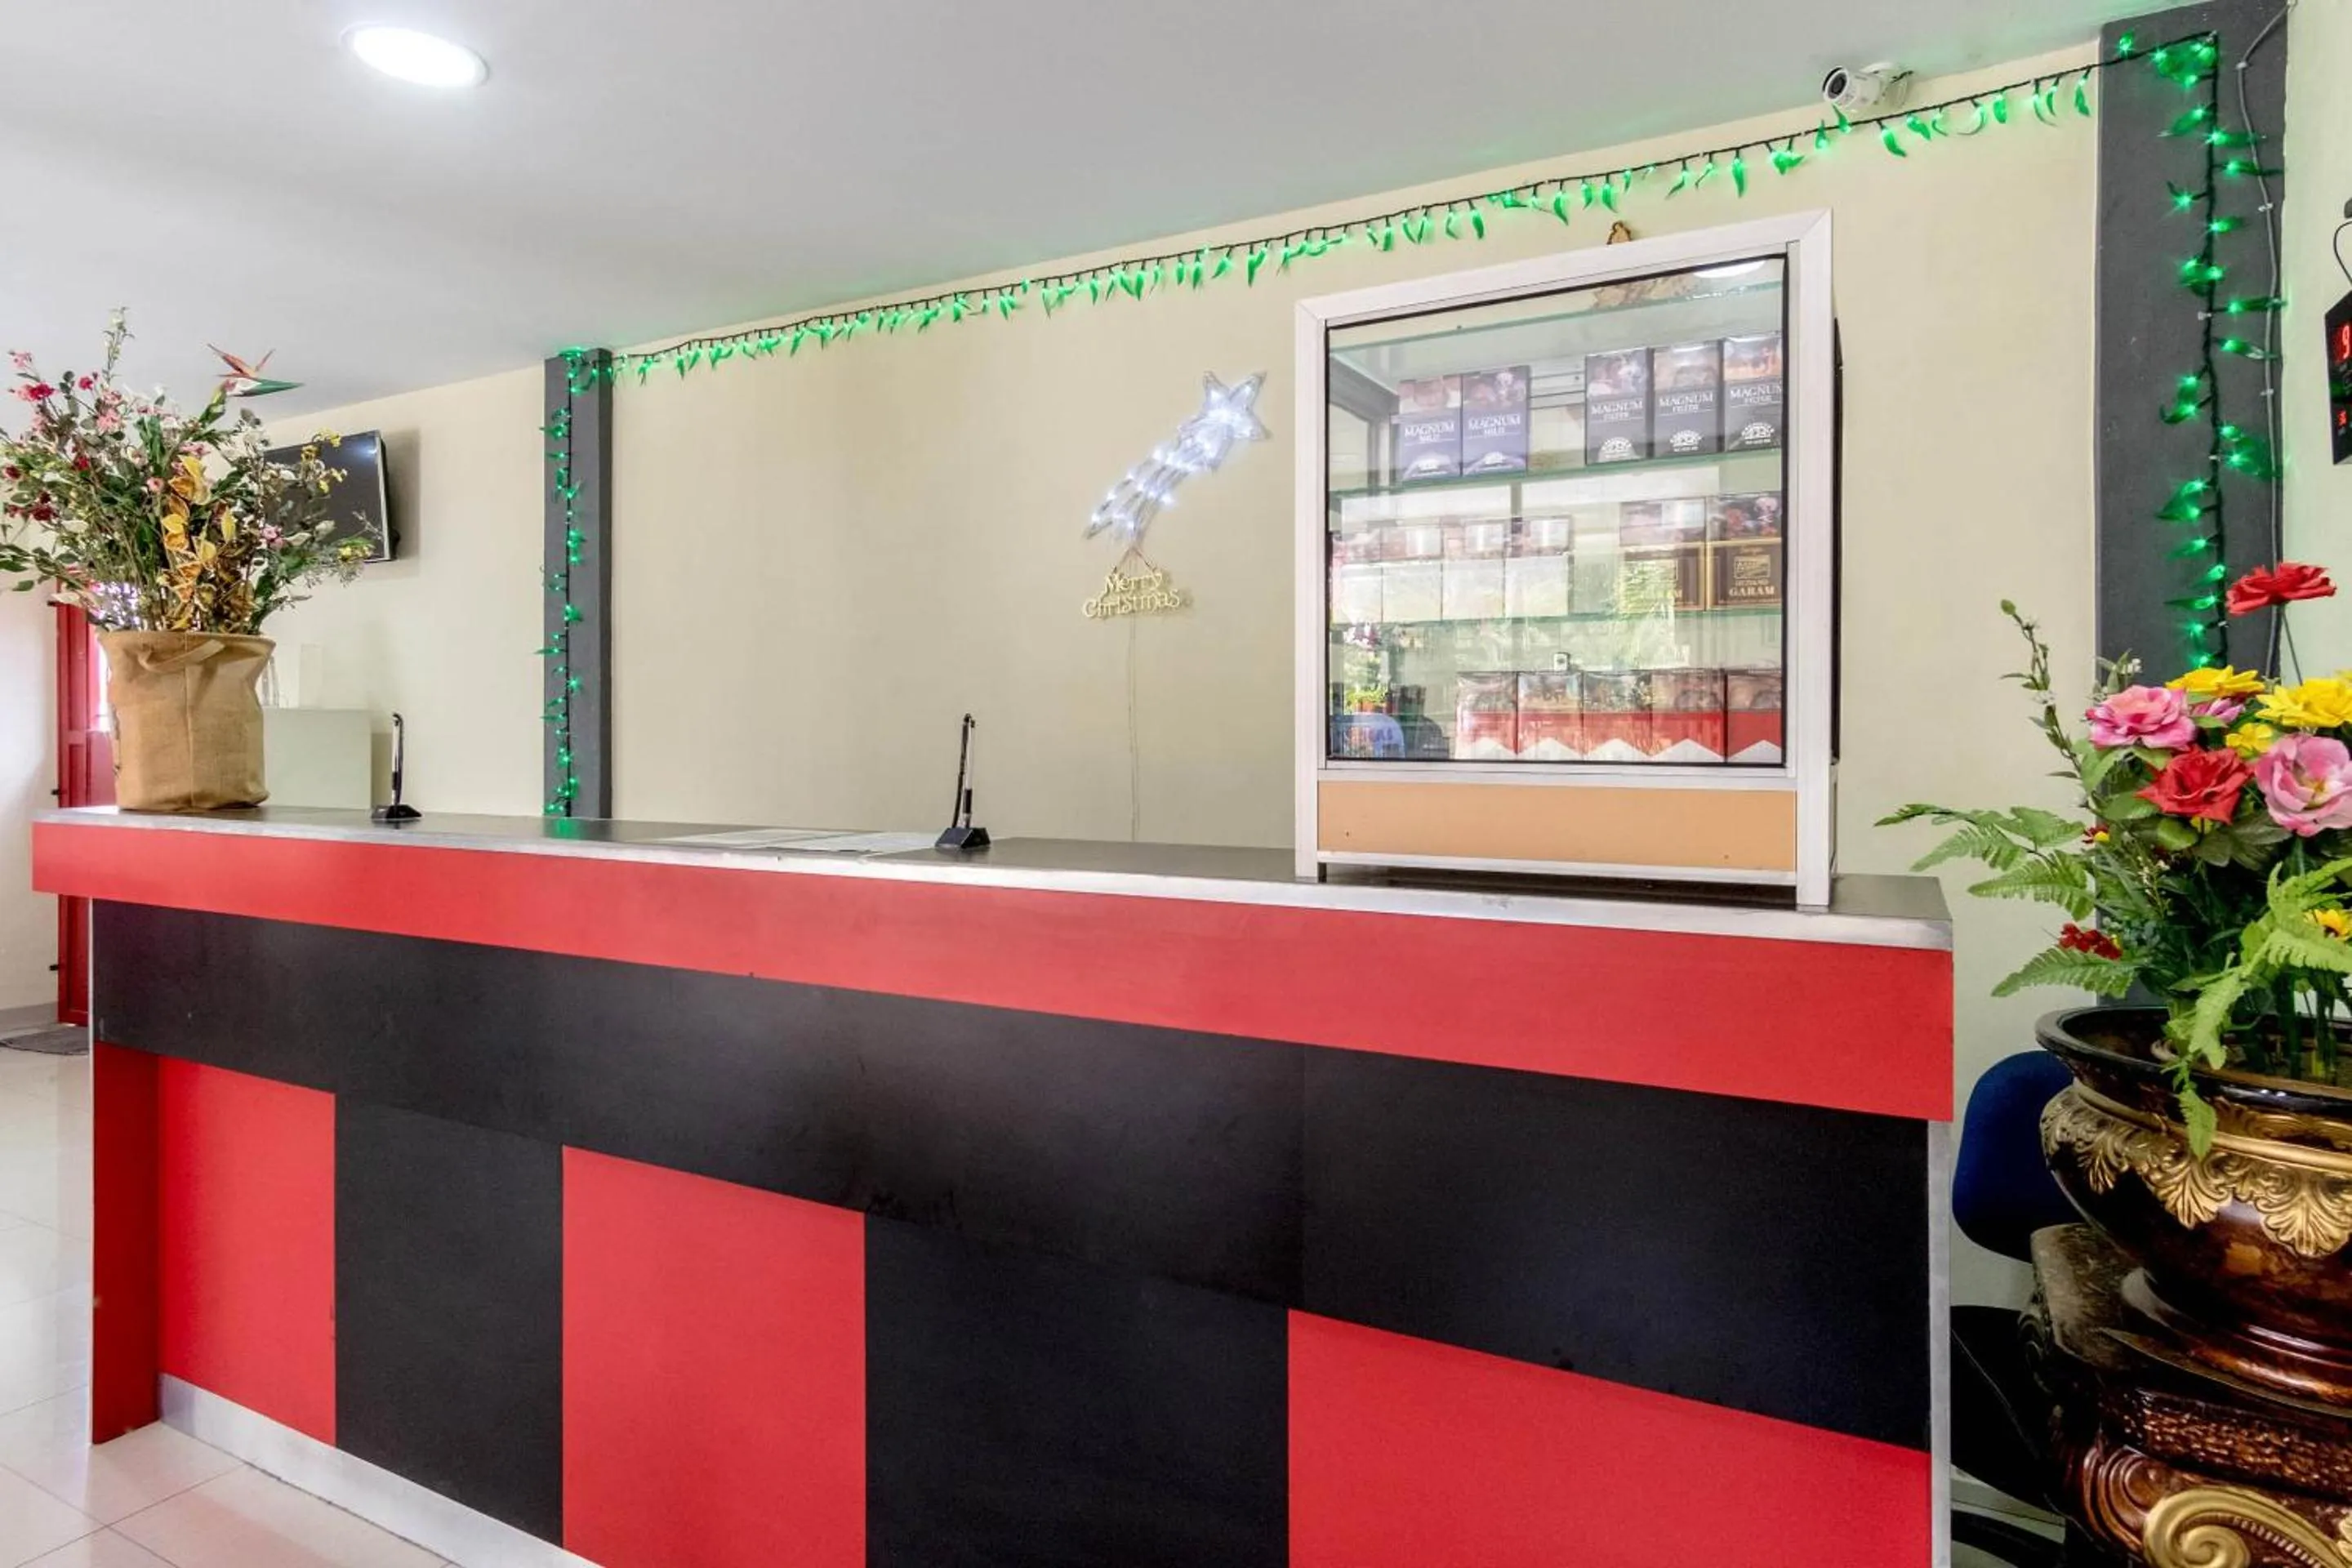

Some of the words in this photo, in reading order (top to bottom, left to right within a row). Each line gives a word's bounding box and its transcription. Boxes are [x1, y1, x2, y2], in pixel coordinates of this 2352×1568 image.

[1591, 398, 1643, 414] MAGNUM
[1659, 390, 1713, 407] MAGNUM
[1405, 420, 1455, 437] MAGNUM
[1468, 413, 1521, 430] MAGNUM
[1105, 571, 1163, 593] Merry
[1729, 585, 1775, 597] GARAM
[1083, 588, 1180, 617] Christmas
